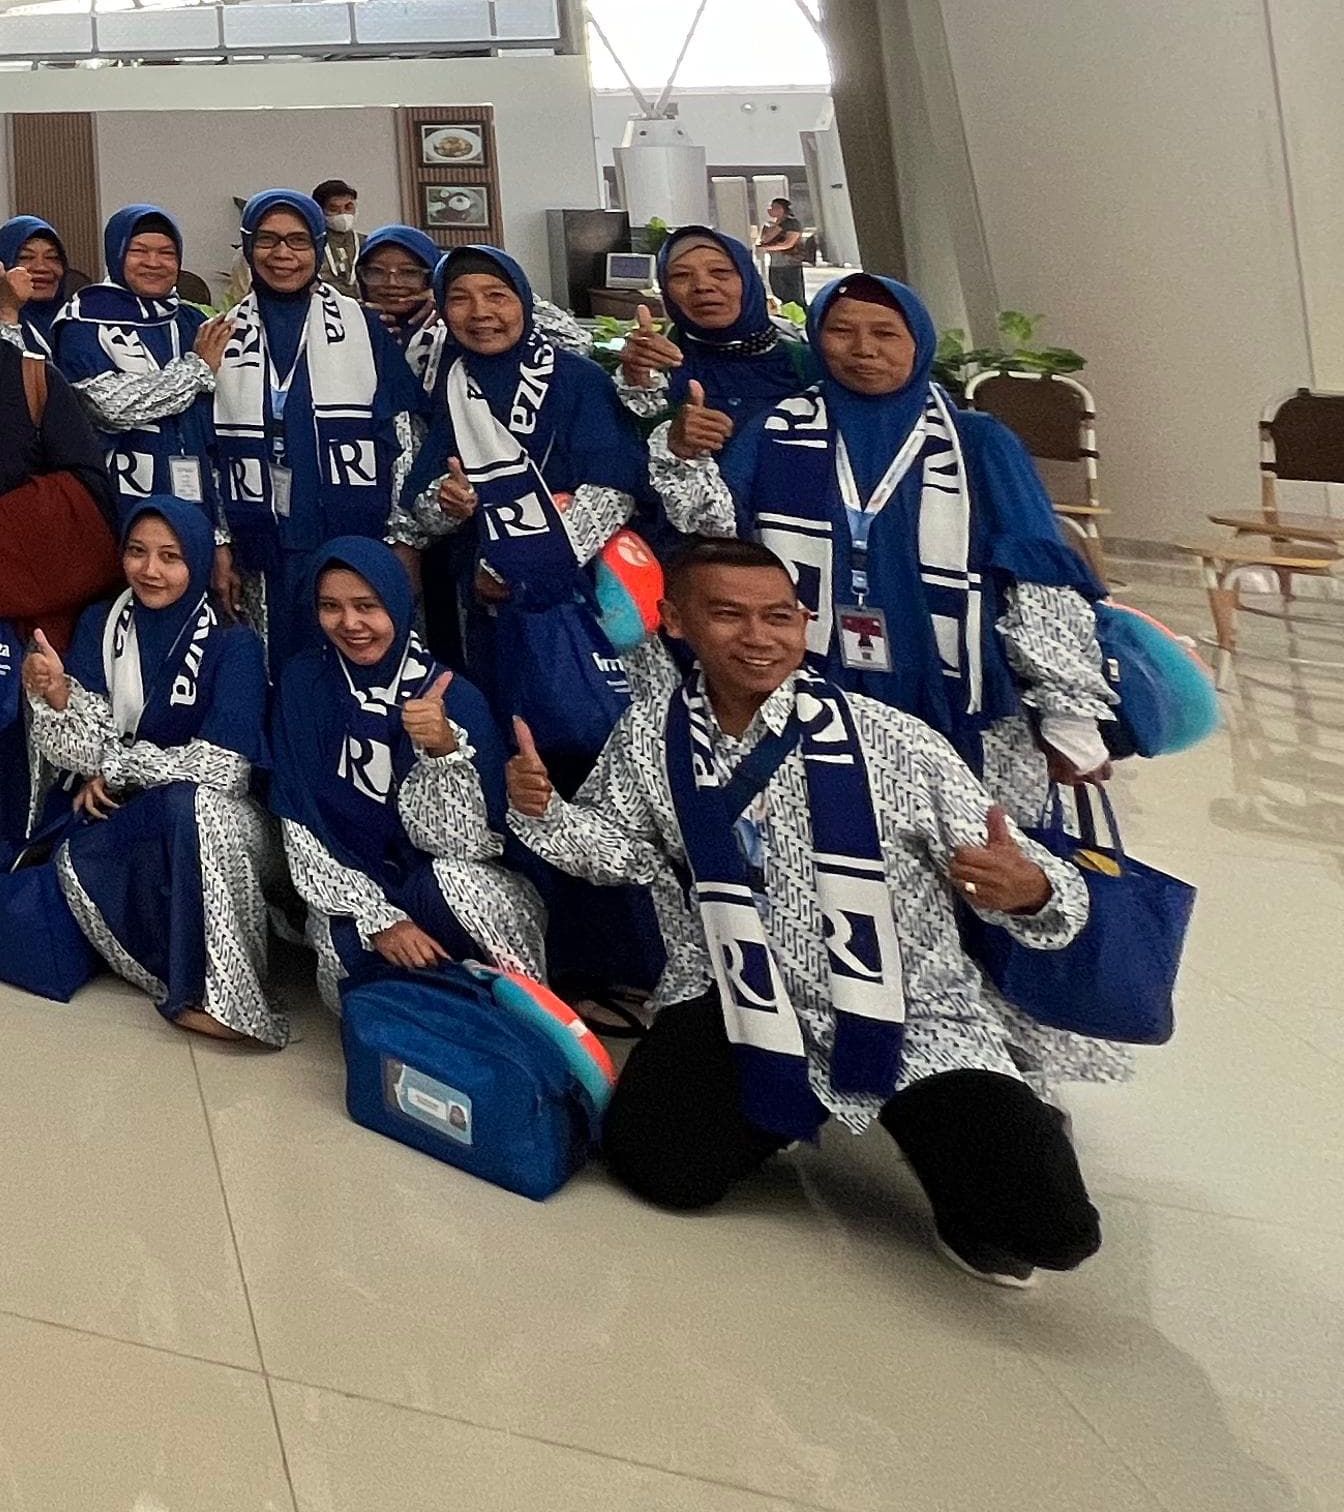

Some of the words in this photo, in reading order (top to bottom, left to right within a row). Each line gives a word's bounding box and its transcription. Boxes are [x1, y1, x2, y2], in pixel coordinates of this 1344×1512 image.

[110, 449, 153, 496] R
[228, 457, 263, 502] R
[329, 440, 376, 486] R
[341, 734, 391, 804] R
